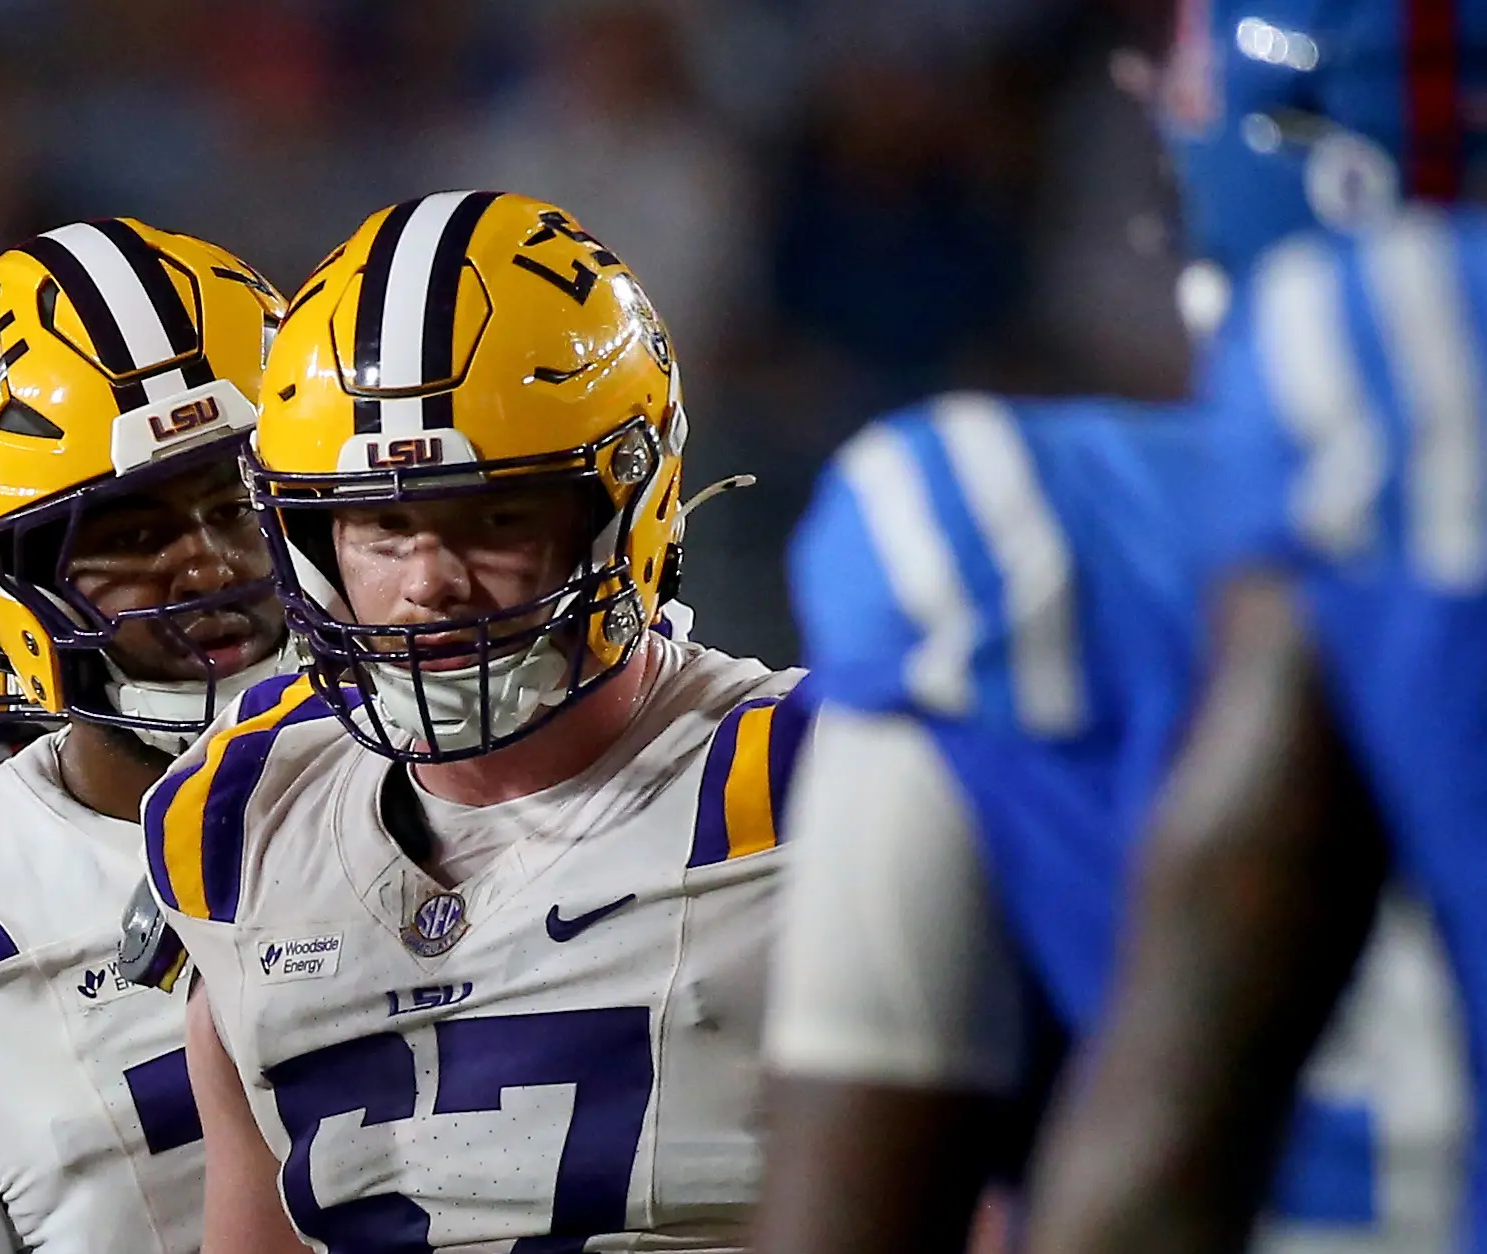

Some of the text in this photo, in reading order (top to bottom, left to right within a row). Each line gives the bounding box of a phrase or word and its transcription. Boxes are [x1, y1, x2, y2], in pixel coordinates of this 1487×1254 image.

[147, 395, 219, 442] LSU
[366, 436, 443, 468] LSU
[416, 895, 462, 940] SEC
[285, 937, 339, 956] Woodside
[284, 958, 325, 974] Energy
[385, 982, 473, 1017] LSU
